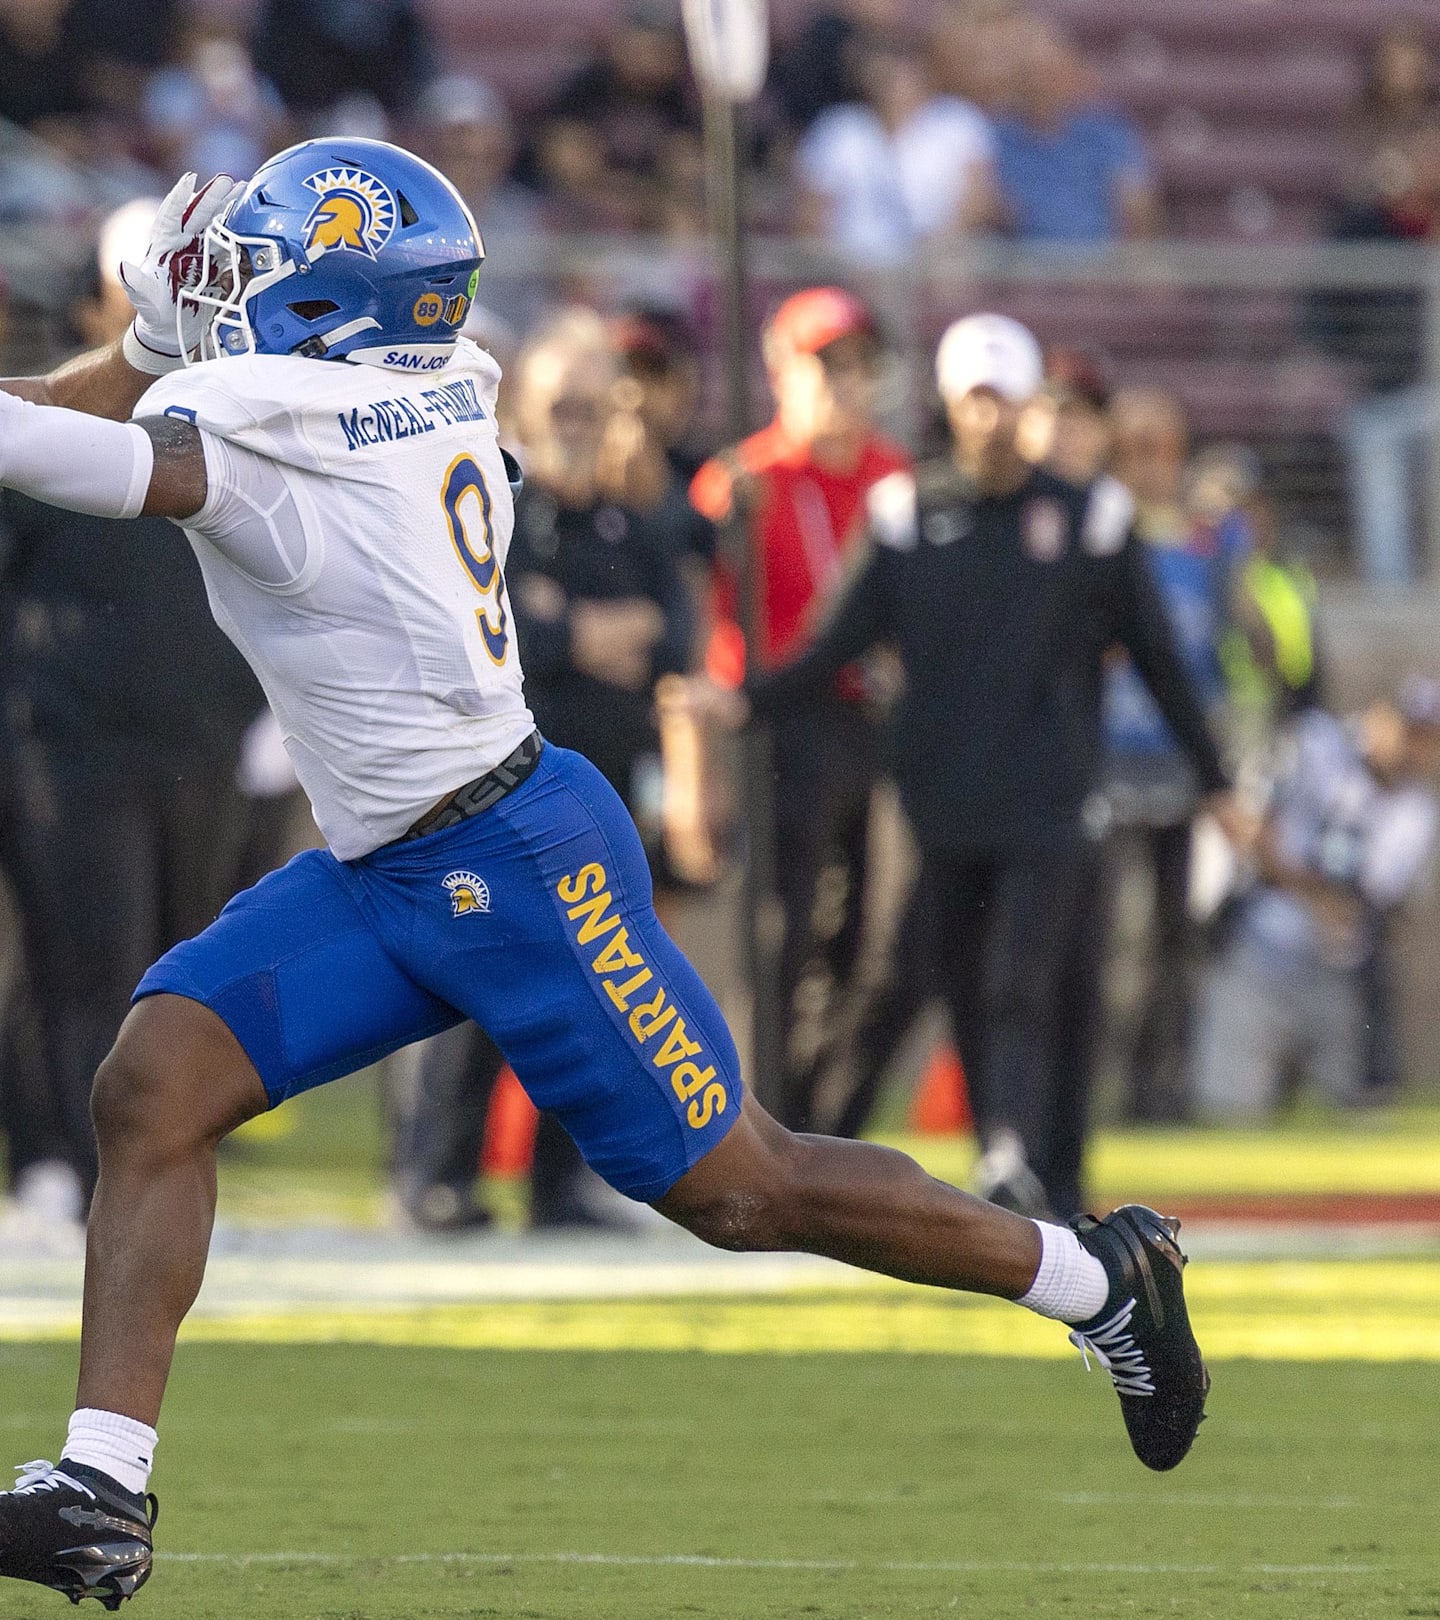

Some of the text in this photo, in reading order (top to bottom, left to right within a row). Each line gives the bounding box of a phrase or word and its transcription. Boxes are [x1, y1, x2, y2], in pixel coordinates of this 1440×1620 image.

[383, 351, 454, 370] SAN JOS
[416, 301, 439, 318] 89
[440, 451, 509, 668] 9
[557, 862, 728, 1130] SPARTANS
